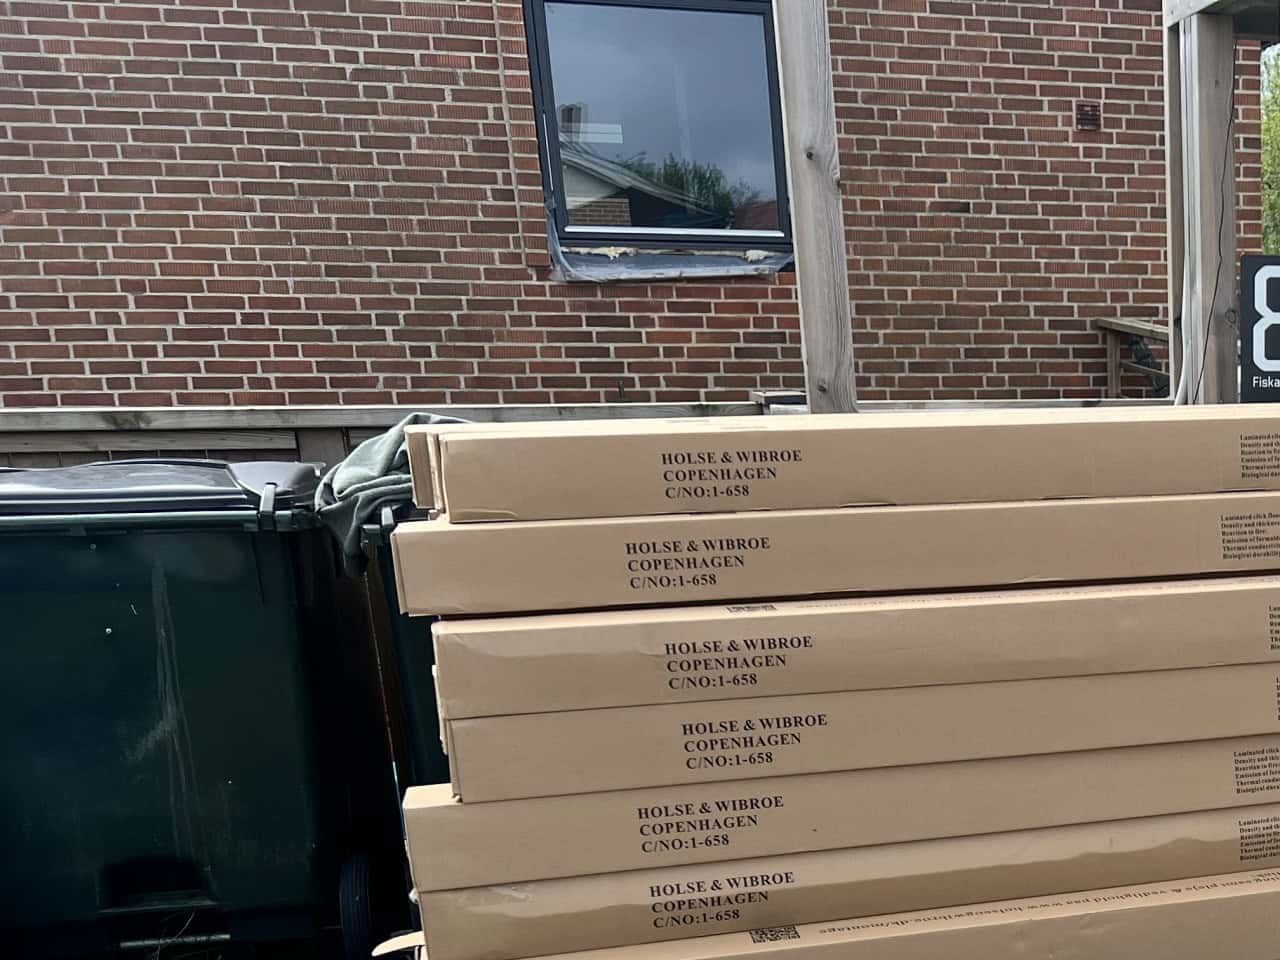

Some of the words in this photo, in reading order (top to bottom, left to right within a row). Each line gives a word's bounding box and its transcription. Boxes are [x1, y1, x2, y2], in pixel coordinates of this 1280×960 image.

[661, 452, 717, 465] HOLSE
[720, 451, 733, 464] &
[735, 449, 802, 463] WIBROE
[663, 467, 777, 482] COPENHAGEN
[665, 484, 750, 499] C/NO:1-658
[625, 540, 683, 555] HOLSE
[686, 540, 699, 552] &
[702, 537, 771, 551] WIBROE
[627, 555, 744, 572] COPENHAGEN
[629, 573, 717, 589] C/NO:1-658
[665, 640, 723, 655] HOLSE
[727, 639, 740, 652] &
[743, 635, 813, 650] WIBROE
[666, 654, 786, 673] COPENHAGEN
[668, 673, 757, 690] C/NO:1-658
[682, 720, 739, 736] HOLSE
[743, 719, 756, 731] &
[758, 713, 828, 729] WIBROE
[684, 732, 801, 753] COPENHAGEN
[686, 751, 773, 770] C/NO:1-658
[637, 803, 695, 820] HOLSE
[699, 802, 711, 814] &
[714, 795, 784, 812] WIBROE
[639, 814, 758, 836] COPENHAGEN
[641, 834, 729, 853] C/NO:1-658
[649, 881, 707, 898] HOLSE
[710, 879, 723, 891] &
[726, 871, 795, 889] WIBROE
[651, 890, 768, 913] COPENHAGEN
[653, 909, 740, 929] C/NO:1-658
